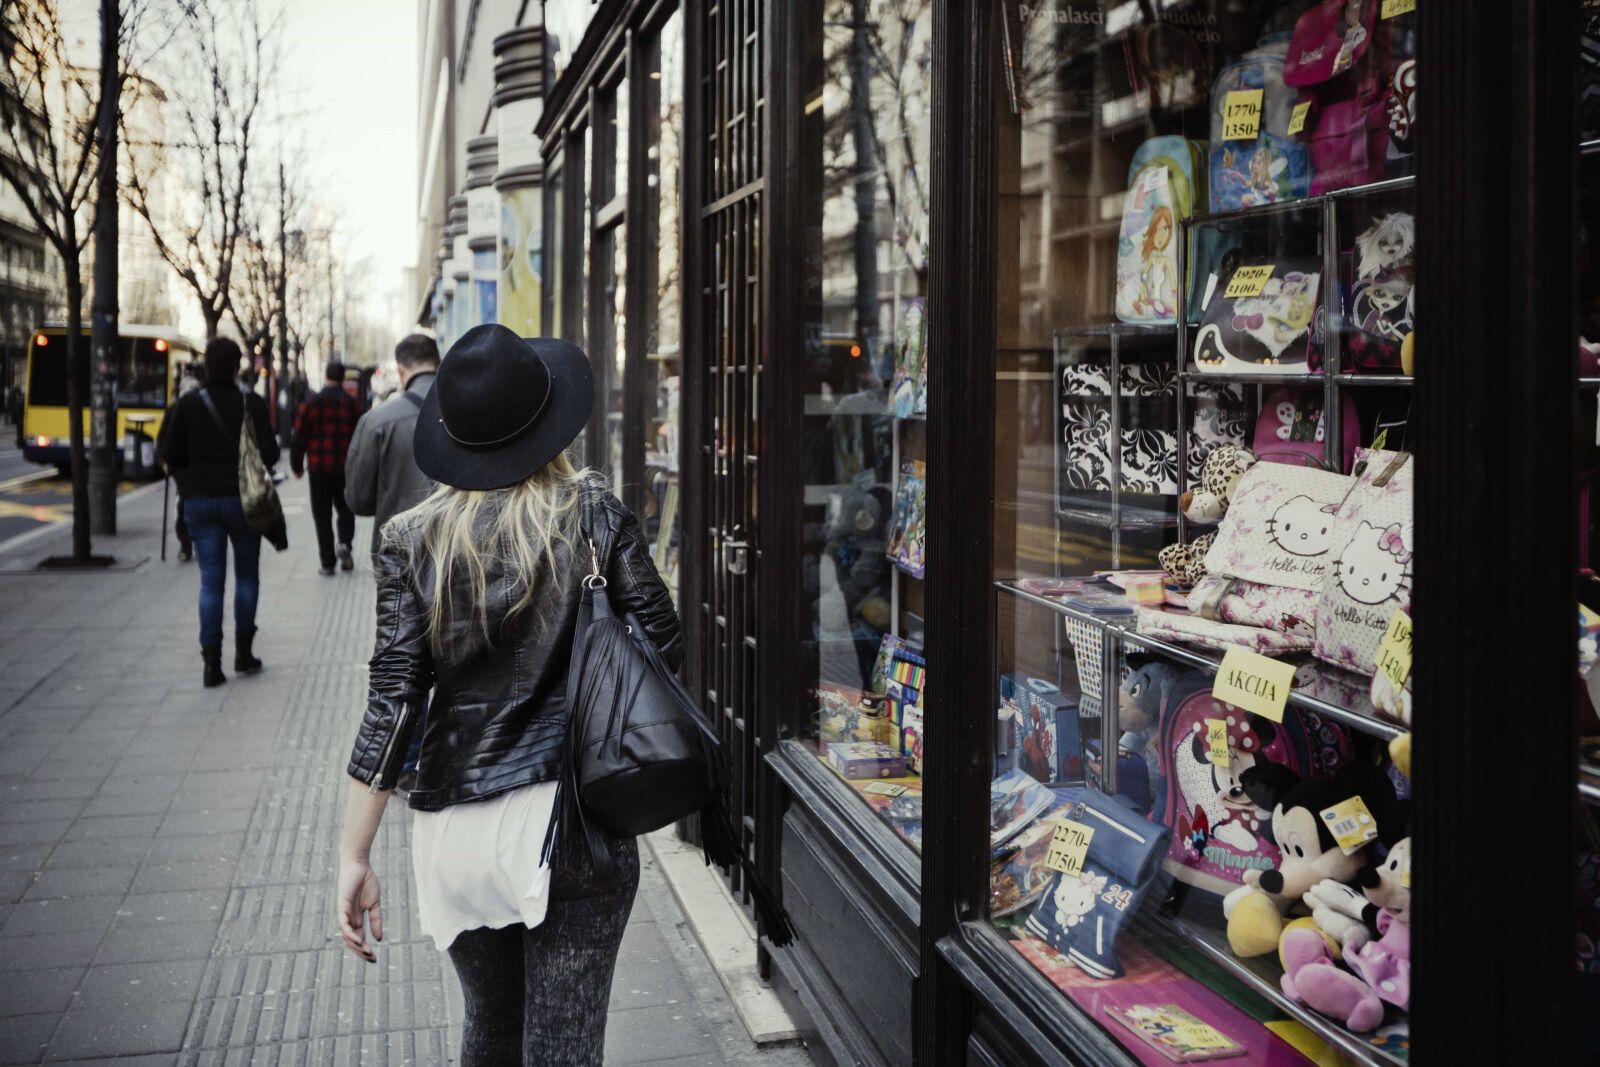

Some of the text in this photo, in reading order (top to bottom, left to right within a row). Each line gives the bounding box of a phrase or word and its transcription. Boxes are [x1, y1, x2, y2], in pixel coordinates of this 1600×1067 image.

[1227, 103, 1261, 118] 1770-
[1225, 123, 1259, 137] 1350-
[1263, 557, 1298, 572] Hello
[1333, 605, 1362, 624] Hello
[1224, 670, 1276, 702] AKCIJA
[1054, 825, 1089, 847] 2270-
[1047, 849, 1081, 872] 1750-
[1203, 846, 1275, 871] Minnie
[1101, 883, 1133, 912] 24
